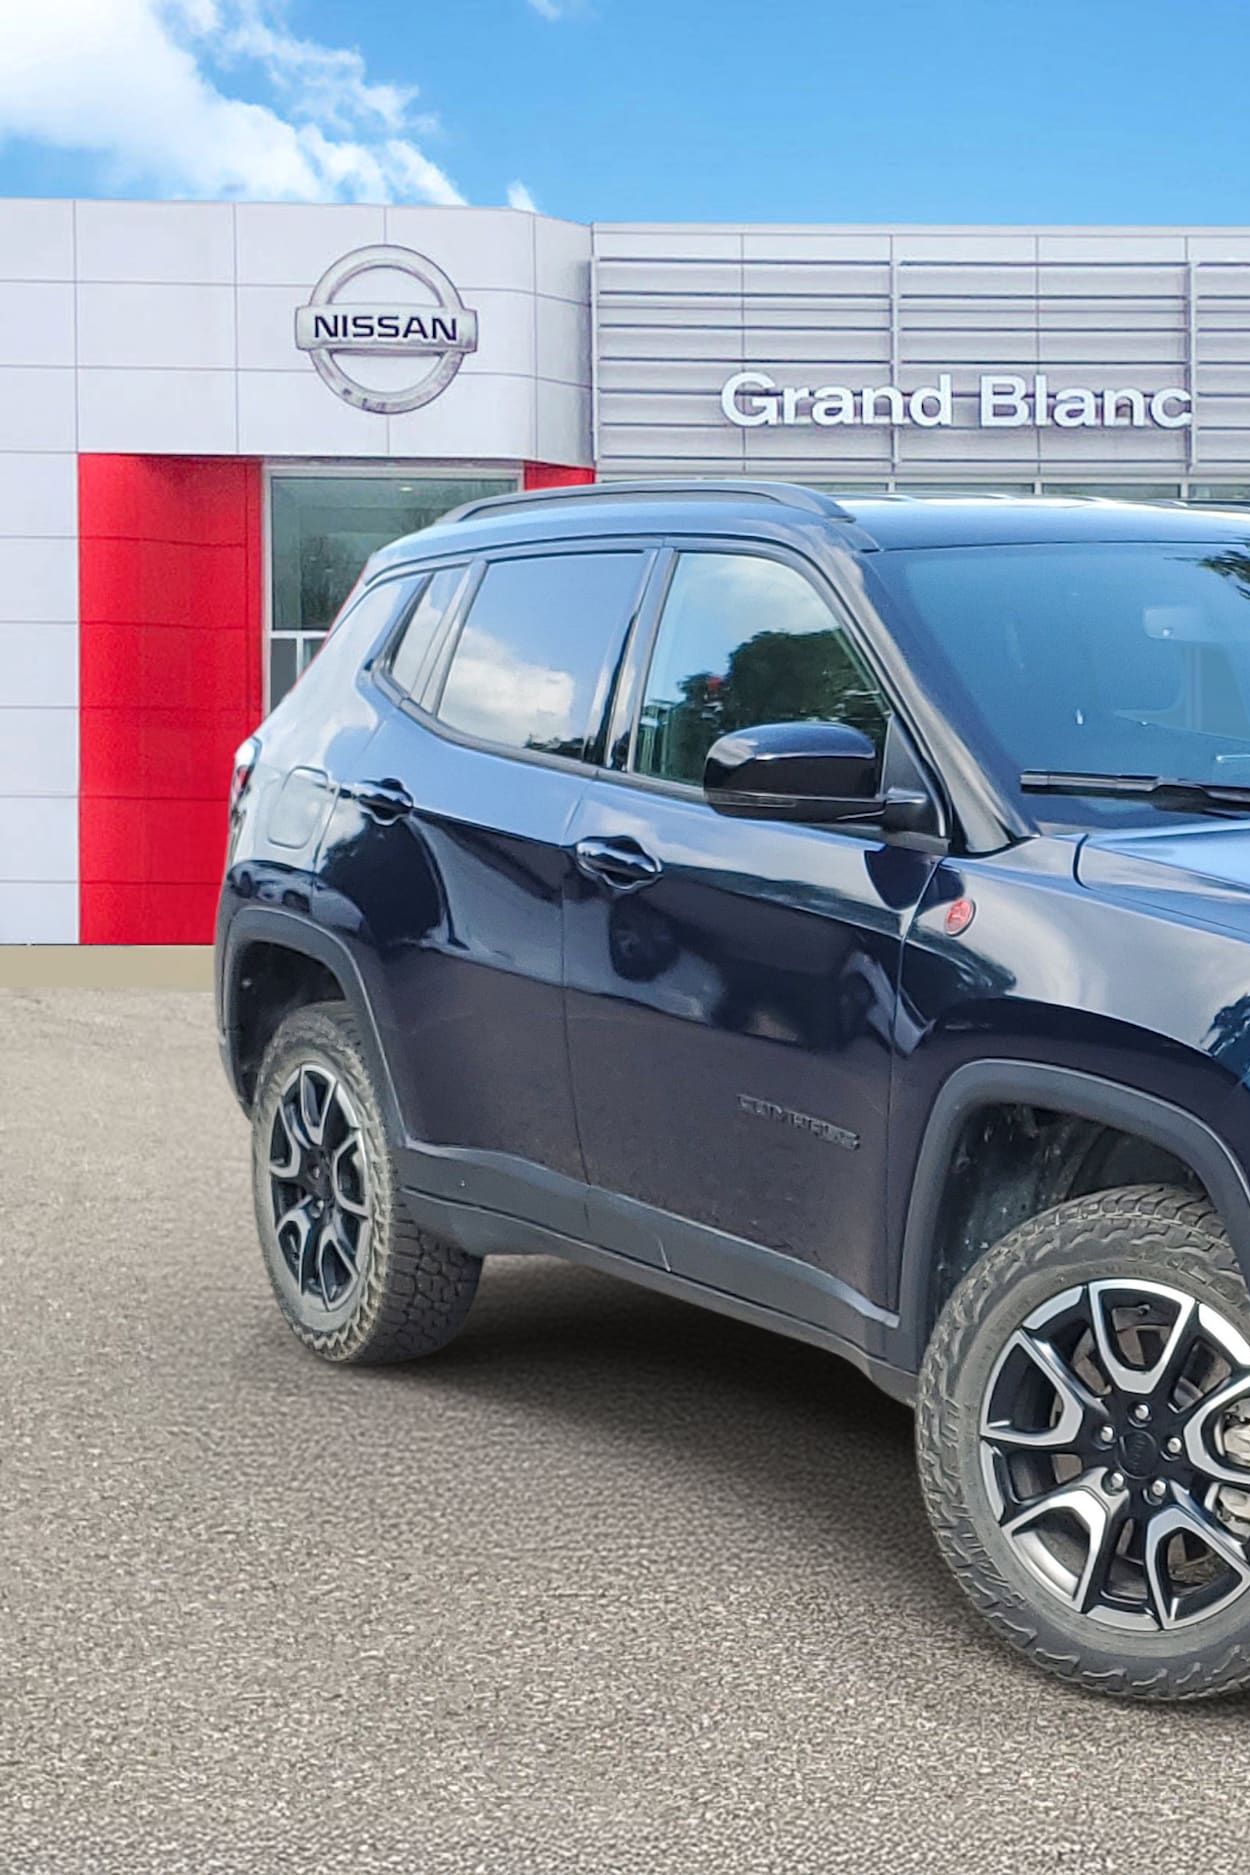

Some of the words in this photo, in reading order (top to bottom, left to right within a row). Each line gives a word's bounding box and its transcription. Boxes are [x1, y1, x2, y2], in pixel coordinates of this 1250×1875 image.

[314, 315, 457, 341] NISSAN
[720, 371, 953, 427] Grand
[979, 374, 1194, 428] Blanc
